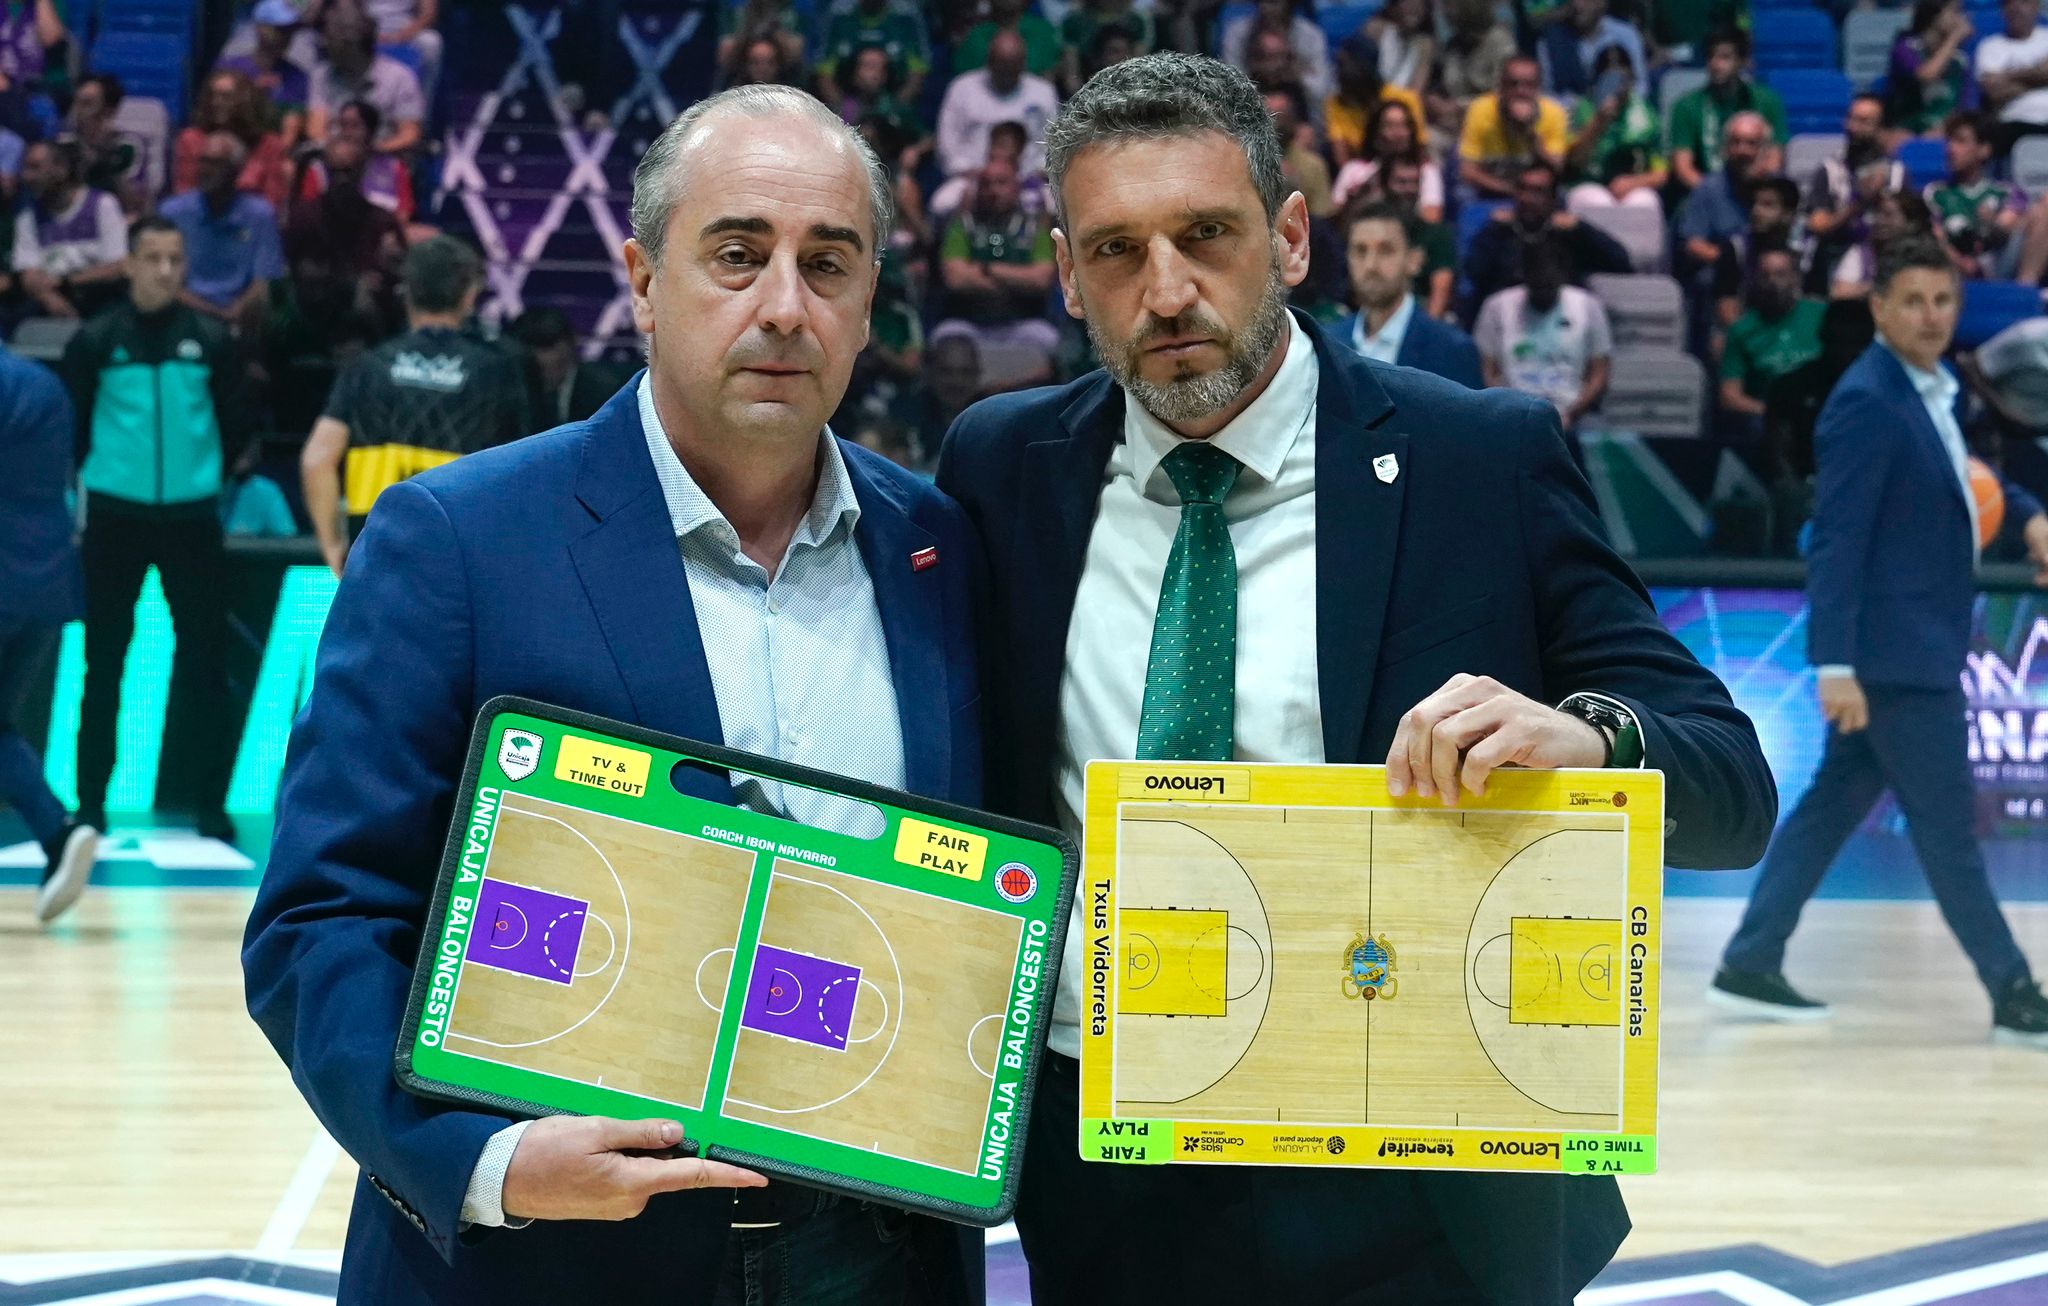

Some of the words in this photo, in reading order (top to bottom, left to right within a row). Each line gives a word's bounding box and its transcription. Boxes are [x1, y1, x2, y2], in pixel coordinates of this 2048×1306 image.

[916, 553, 937, 566] Lenovo
[507, 751, 530, 762] Unicaja
[592, 756, 611, 769] TV
[616, 762, 626, 773] &
[569, 769, 607, 787] TIME
[611, 779, 643, 795] OUT
[1145, 775, 1224, 794] Lenovo
[458, 786, 498, 883] UNICAJA
[927, 831, 970, 853] FAIR
[702, 825, 744, 844] COACH
[746, 836, 776, 852] IBON
[778, 843, 837, 867] NAVARRO
[920, 852, 969, 875] PLAY
[1094, 879, 1111, 929] Txus
[1631, 906, 1648, 936] CB
[420, 895, 473, 1047] BALONCESTO
[1092, 935, 1111, 1036] Vidorreta
[1629, 943, 1648, 1037] Canarias
[982, 1082, 1018, 1181] UNICAJA
[1003, 919, 1047, 1070] BALONCESTO
[1098, 1121, 1149, 1136] PLAY
[1200, 1144, 1223, 1153] Islas
[1201, 1136, 1244, 1146] Canarias
[1273, 1144, 1310, 1153] LAGUNA
[1297, 1136, 1324, 1144] deporte
[1566, 1139, 1599, 1152] OUT
[1604, 1140, 1644, 1152] TIME
[1100, 1146, 1146, 1160] FAIR
[1313, 1145, 1324, 1153] LA
[1480, 1141, 1560, 1160] Lenovo
[1586, 1159, 1597, 1171] &
[1602, 1160, 1624, 1172] TV
